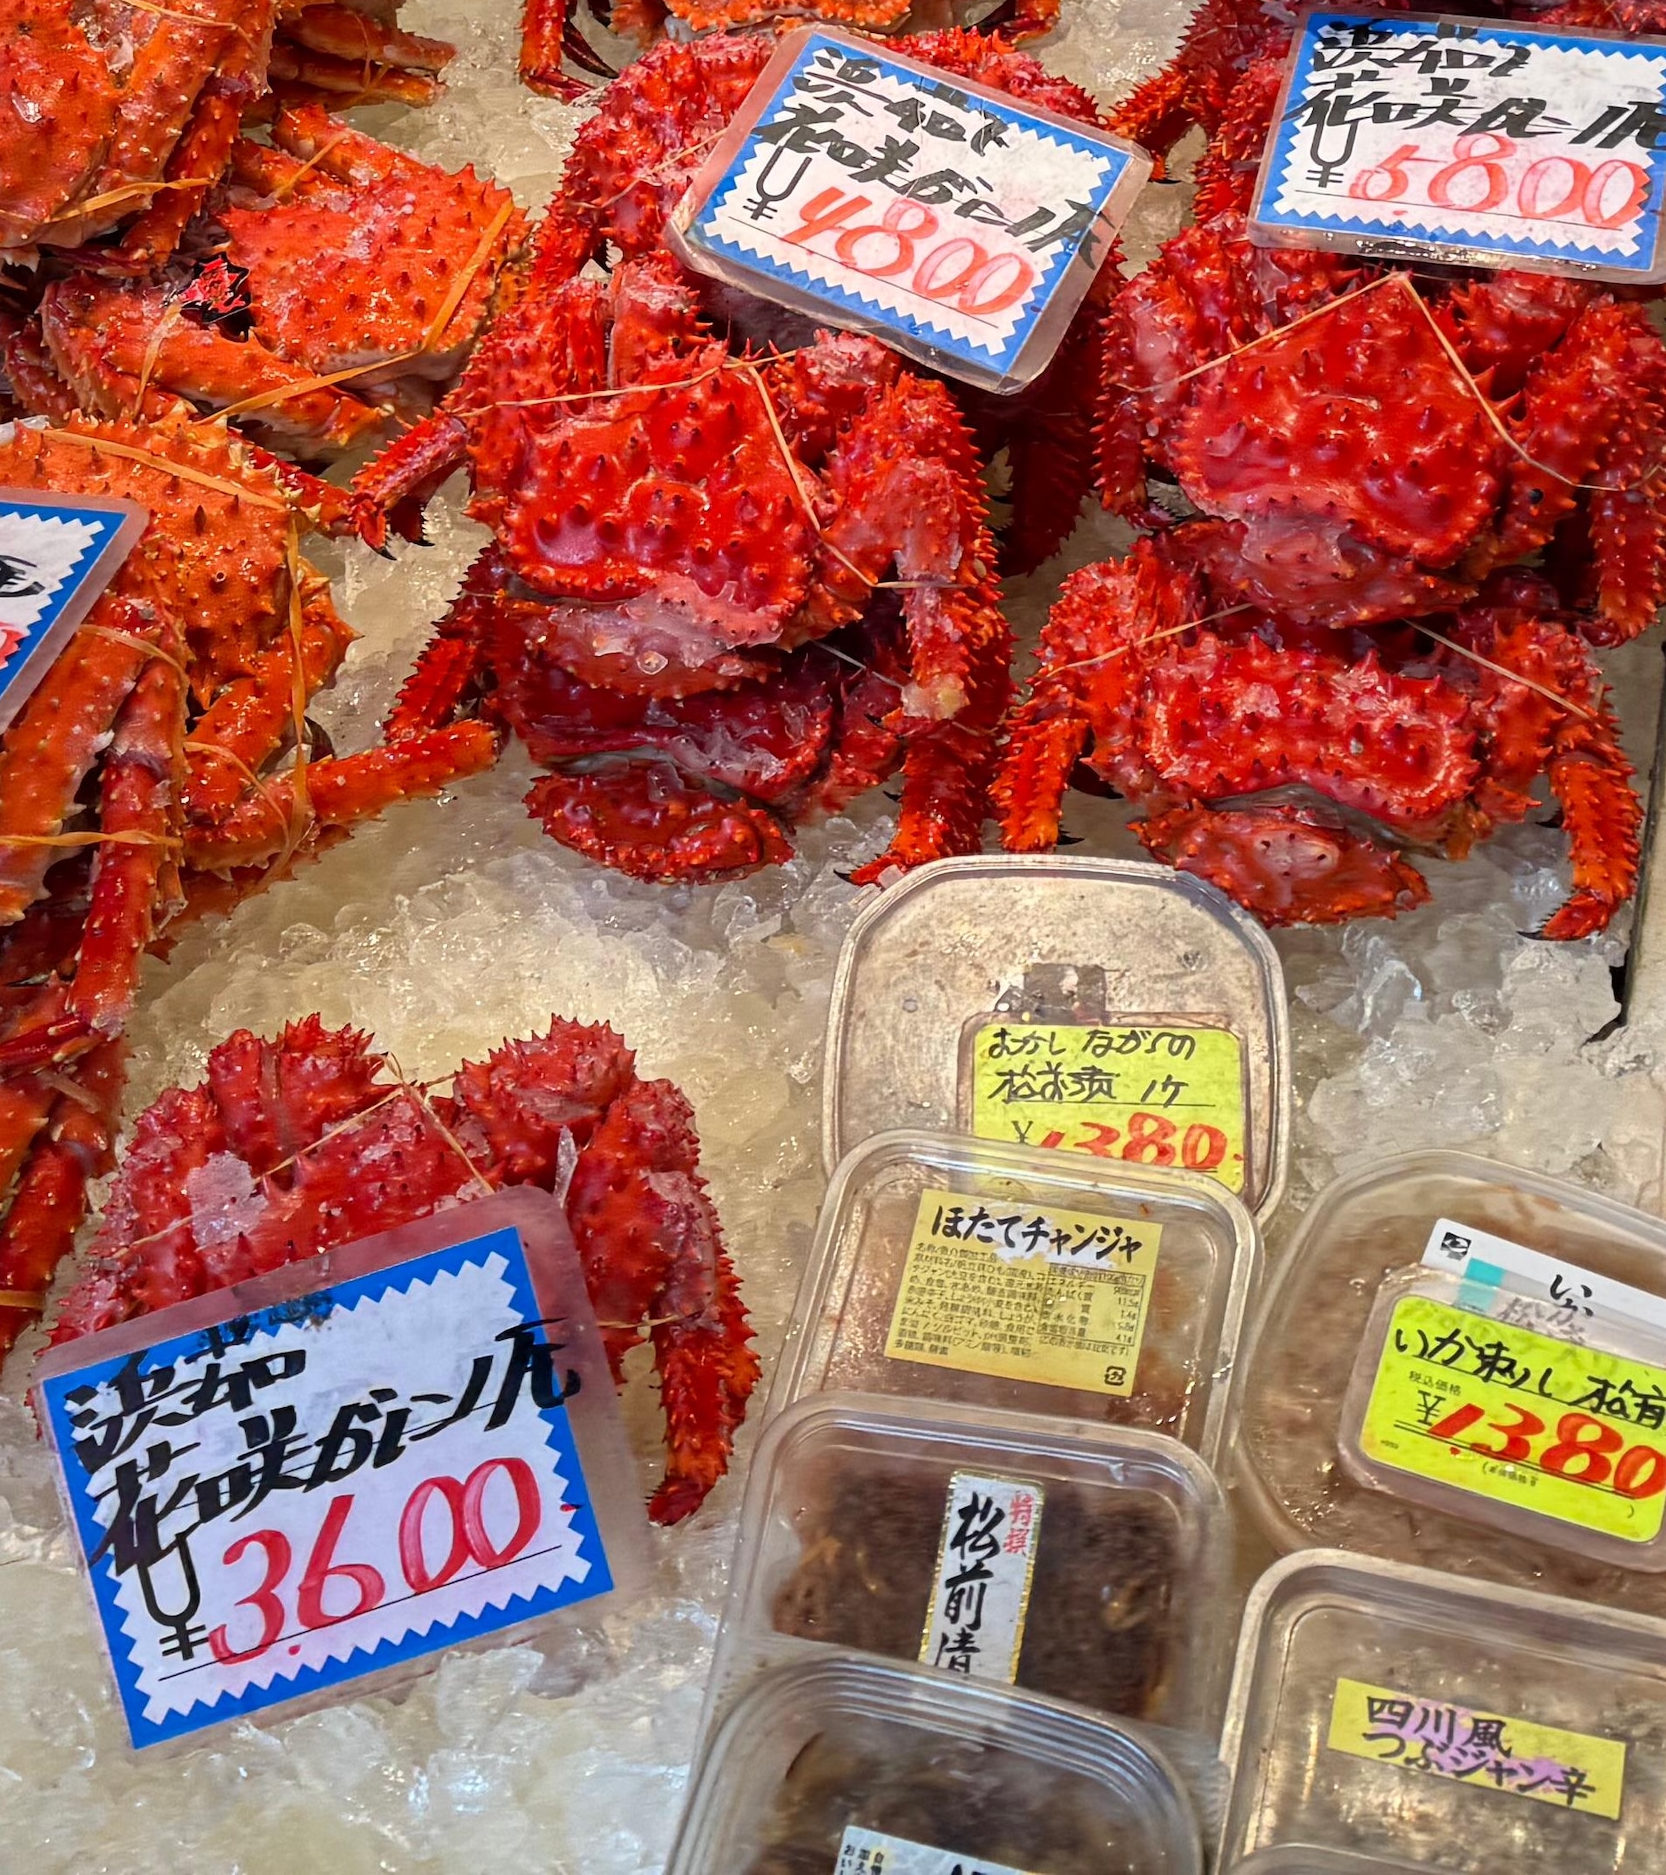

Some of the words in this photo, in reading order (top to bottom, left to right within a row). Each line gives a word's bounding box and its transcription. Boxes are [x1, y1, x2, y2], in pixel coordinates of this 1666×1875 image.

[930, 1204, 1144, 1263] ほたてチャンジャ
[1366, 1694, 1514, 1759] 四川風
